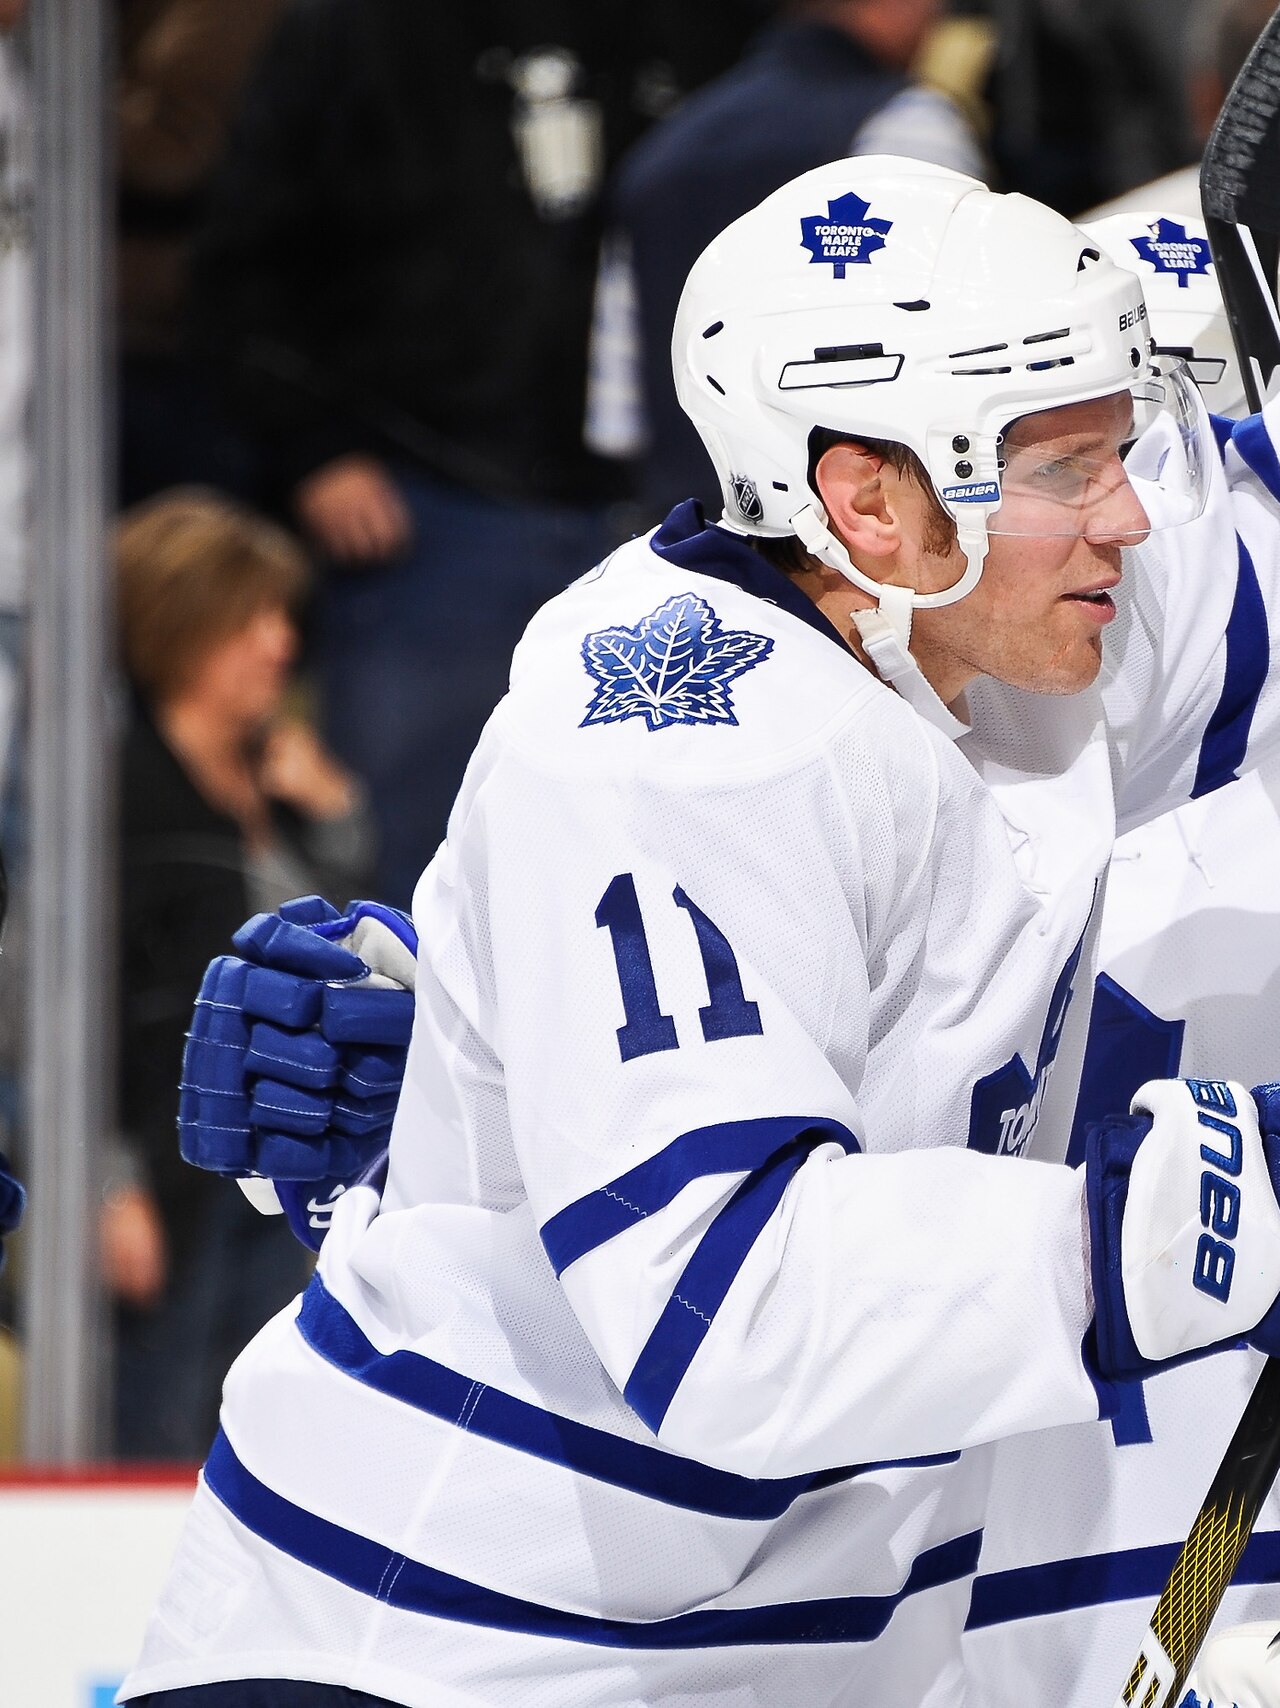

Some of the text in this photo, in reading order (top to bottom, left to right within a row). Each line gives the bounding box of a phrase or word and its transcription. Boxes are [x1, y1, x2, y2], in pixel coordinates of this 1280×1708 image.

[814, 225, 875, 237] TORONTO
[821, 235, 862, 246] MAPLE
[823, 245, 859, 257] LEAFS
[1147, 242, 1202, 253] TORONTO
[1158, 251, 1197, 260] MAPLE
[1163, 259, 1197, 269] LEAFS
[1119, 302, 1148, 332] BAUE
[594, 873, 764, 1064] 11
[1186, 1081, 1243, 1305] BAUE
